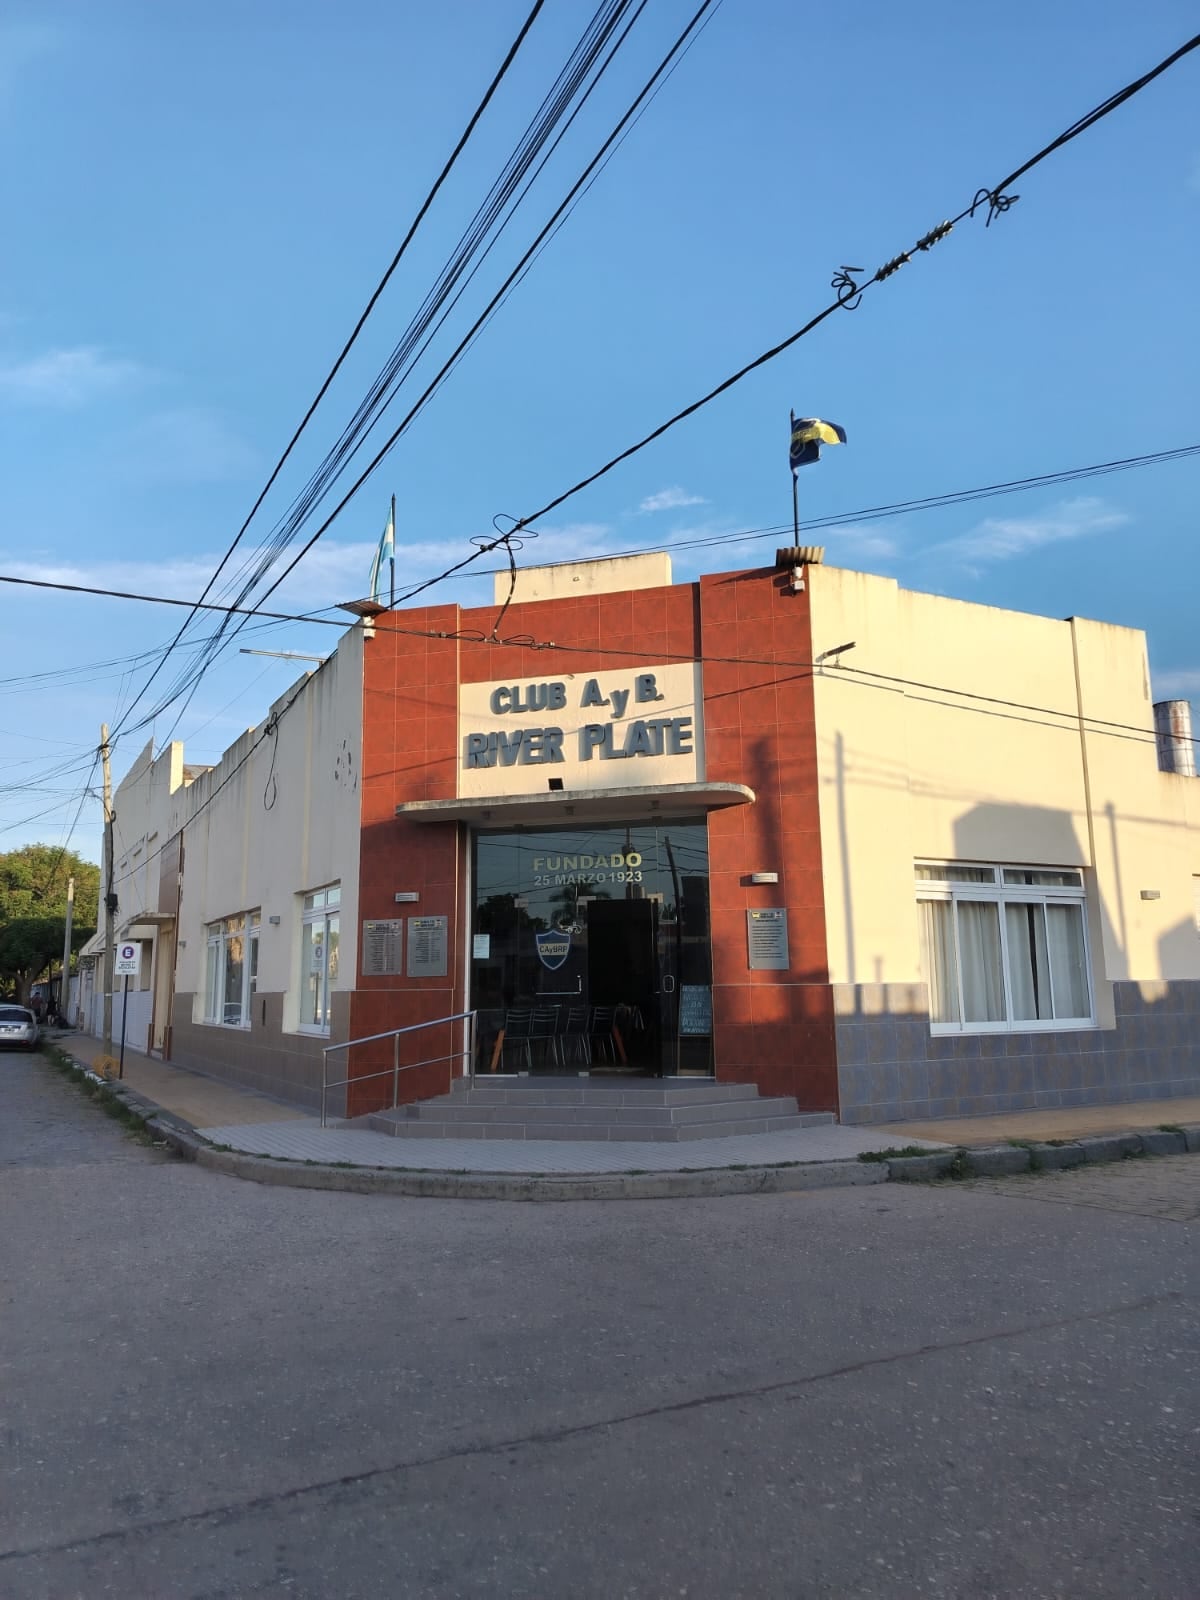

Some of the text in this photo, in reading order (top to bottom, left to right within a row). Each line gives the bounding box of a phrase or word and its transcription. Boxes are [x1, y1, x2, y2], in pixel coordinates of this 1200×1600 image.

[490, 682, 567, 715] CLUB
[463, 716, 693, 769] RIVER PLATE
[532, 852, 642, 872] FUNDADO
[534, 871, 643, 886] 25 MARZO 1923
